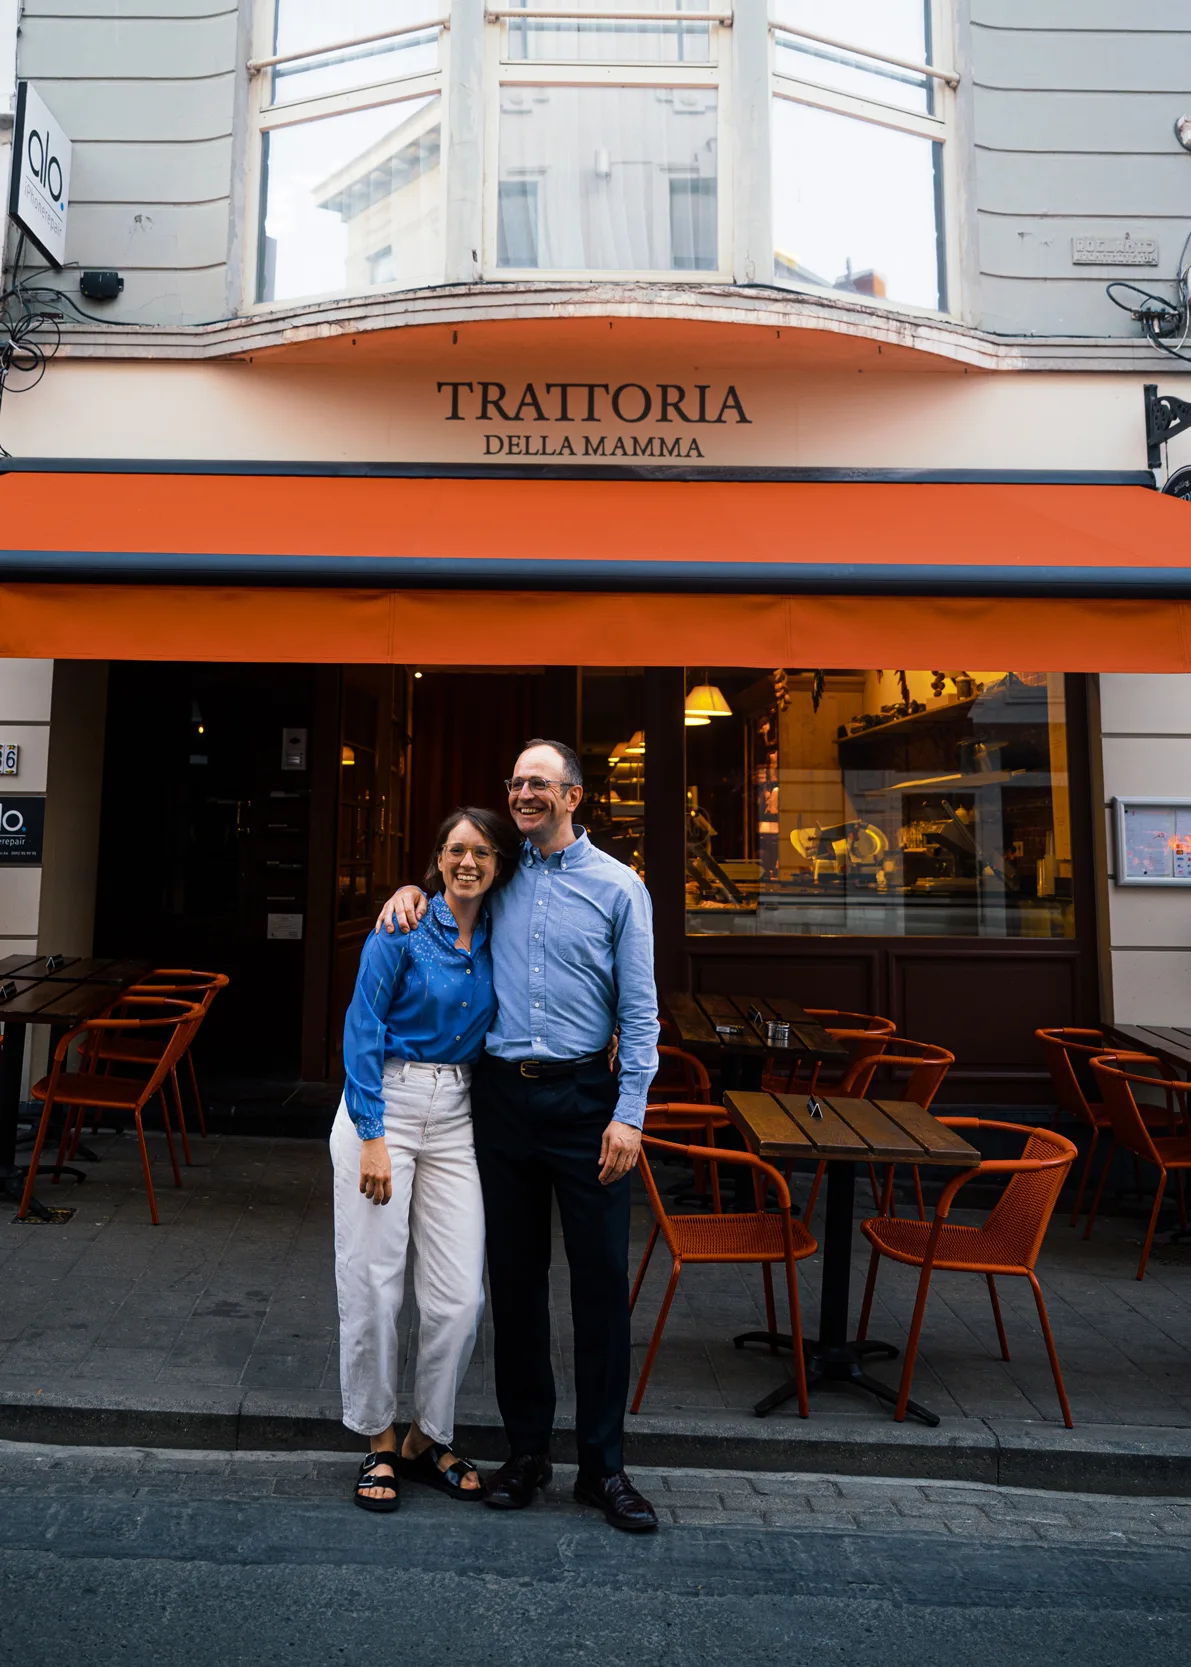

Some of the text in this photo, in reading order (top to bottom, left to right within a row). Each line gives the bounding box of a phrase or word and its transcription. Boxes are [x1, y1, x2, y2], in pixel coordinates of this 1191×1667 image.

[437, 381, 753, 424] TRATTORIA
[483, 434, 705, 458] DELLA MAMMA
